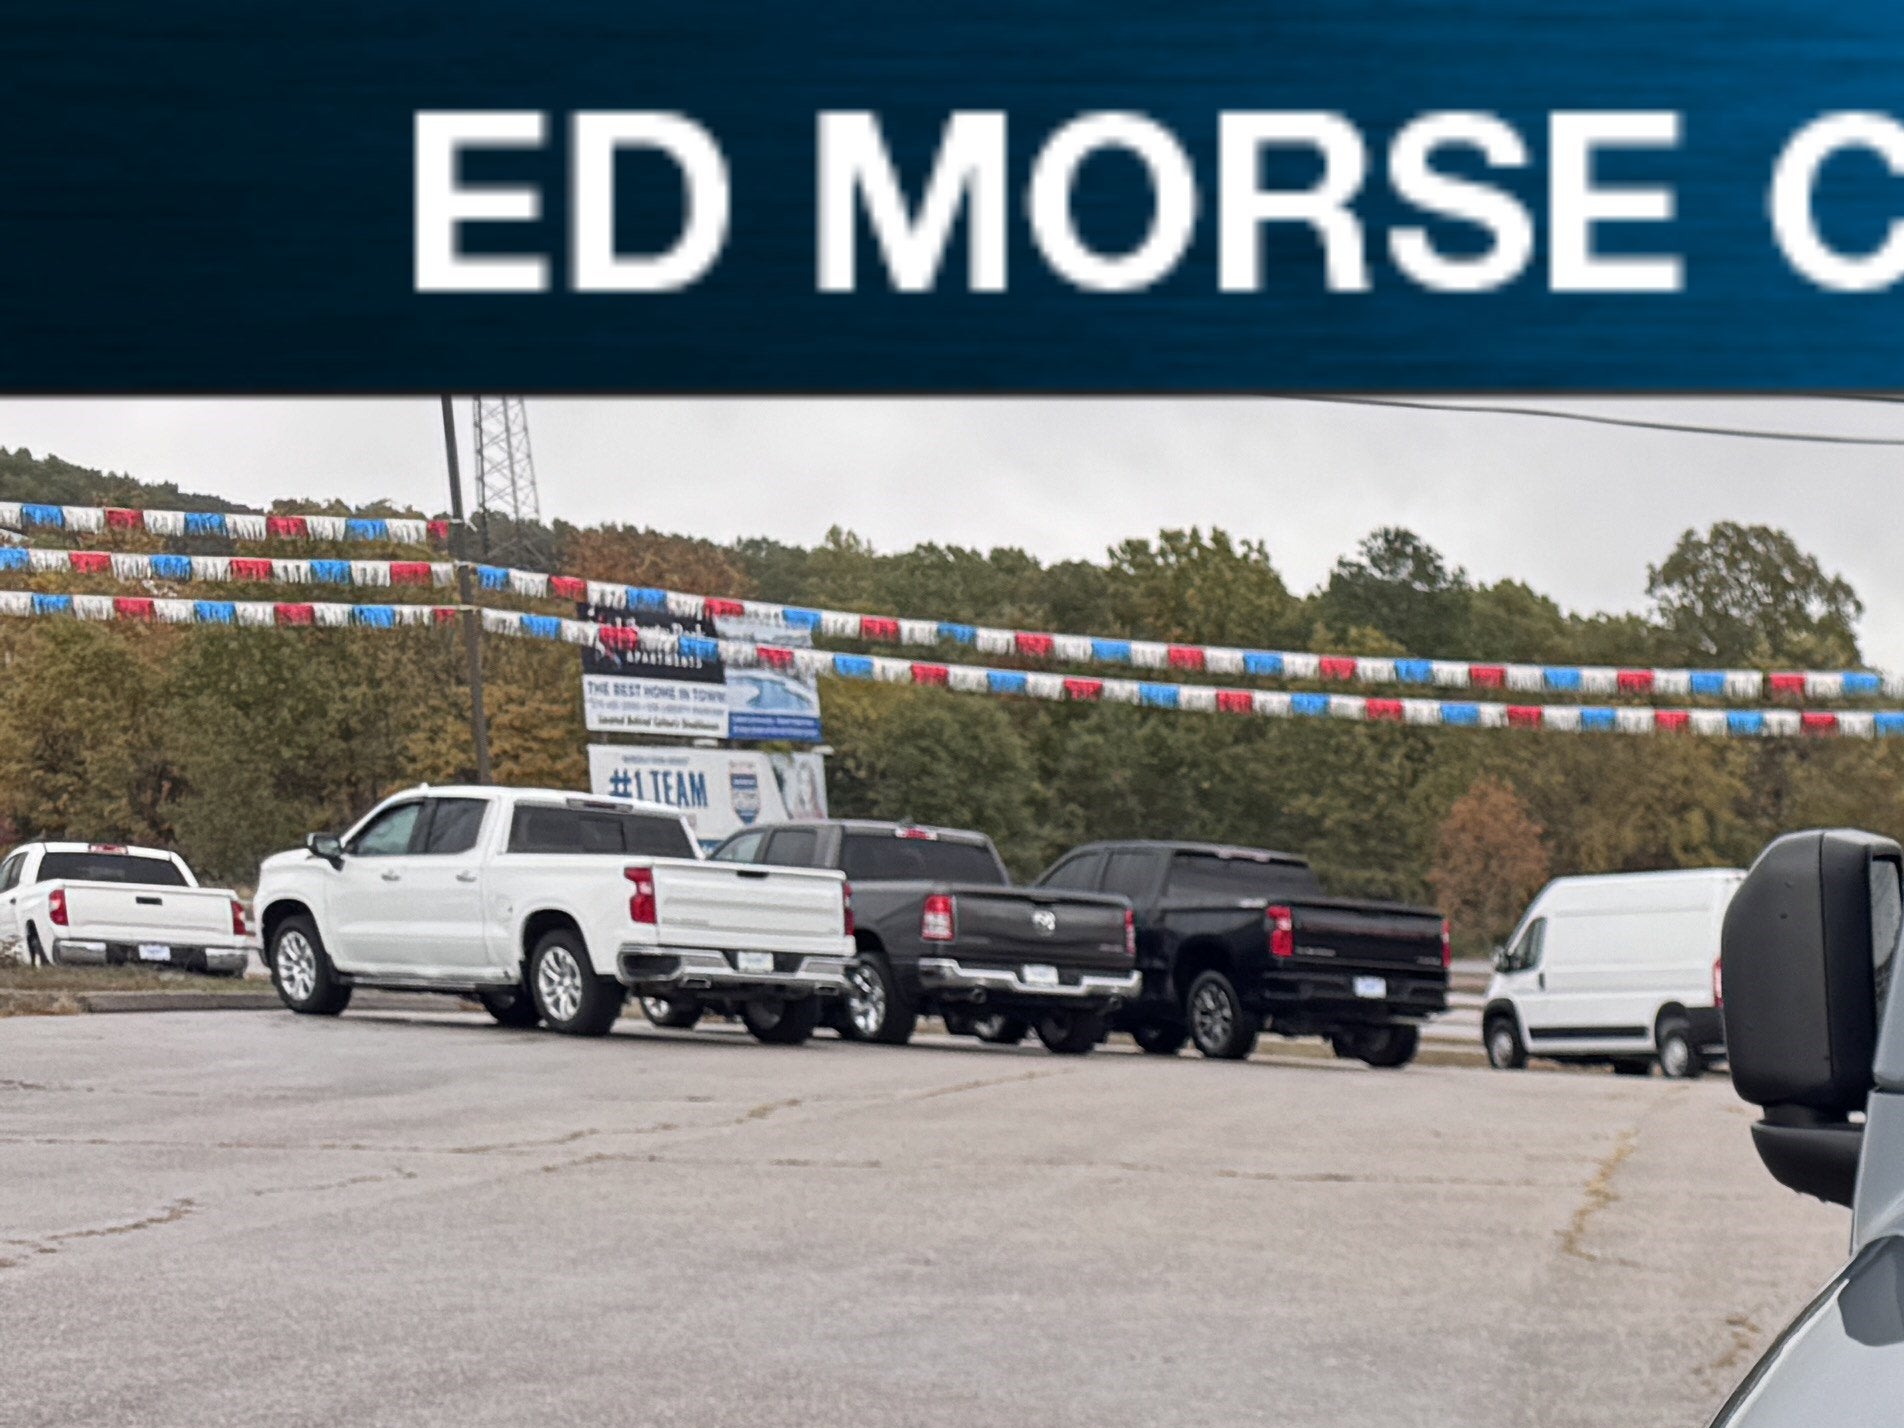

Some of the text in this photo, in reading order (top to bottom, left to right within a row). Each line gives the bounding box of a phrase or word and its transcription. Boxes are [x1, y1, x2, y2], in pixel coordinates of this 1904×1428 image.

[587, 681, 726, 702] THE BEST HOME IN TOWN
[609, 767, 645, 801] #1
[650, 769, 709, 808] TEAM
